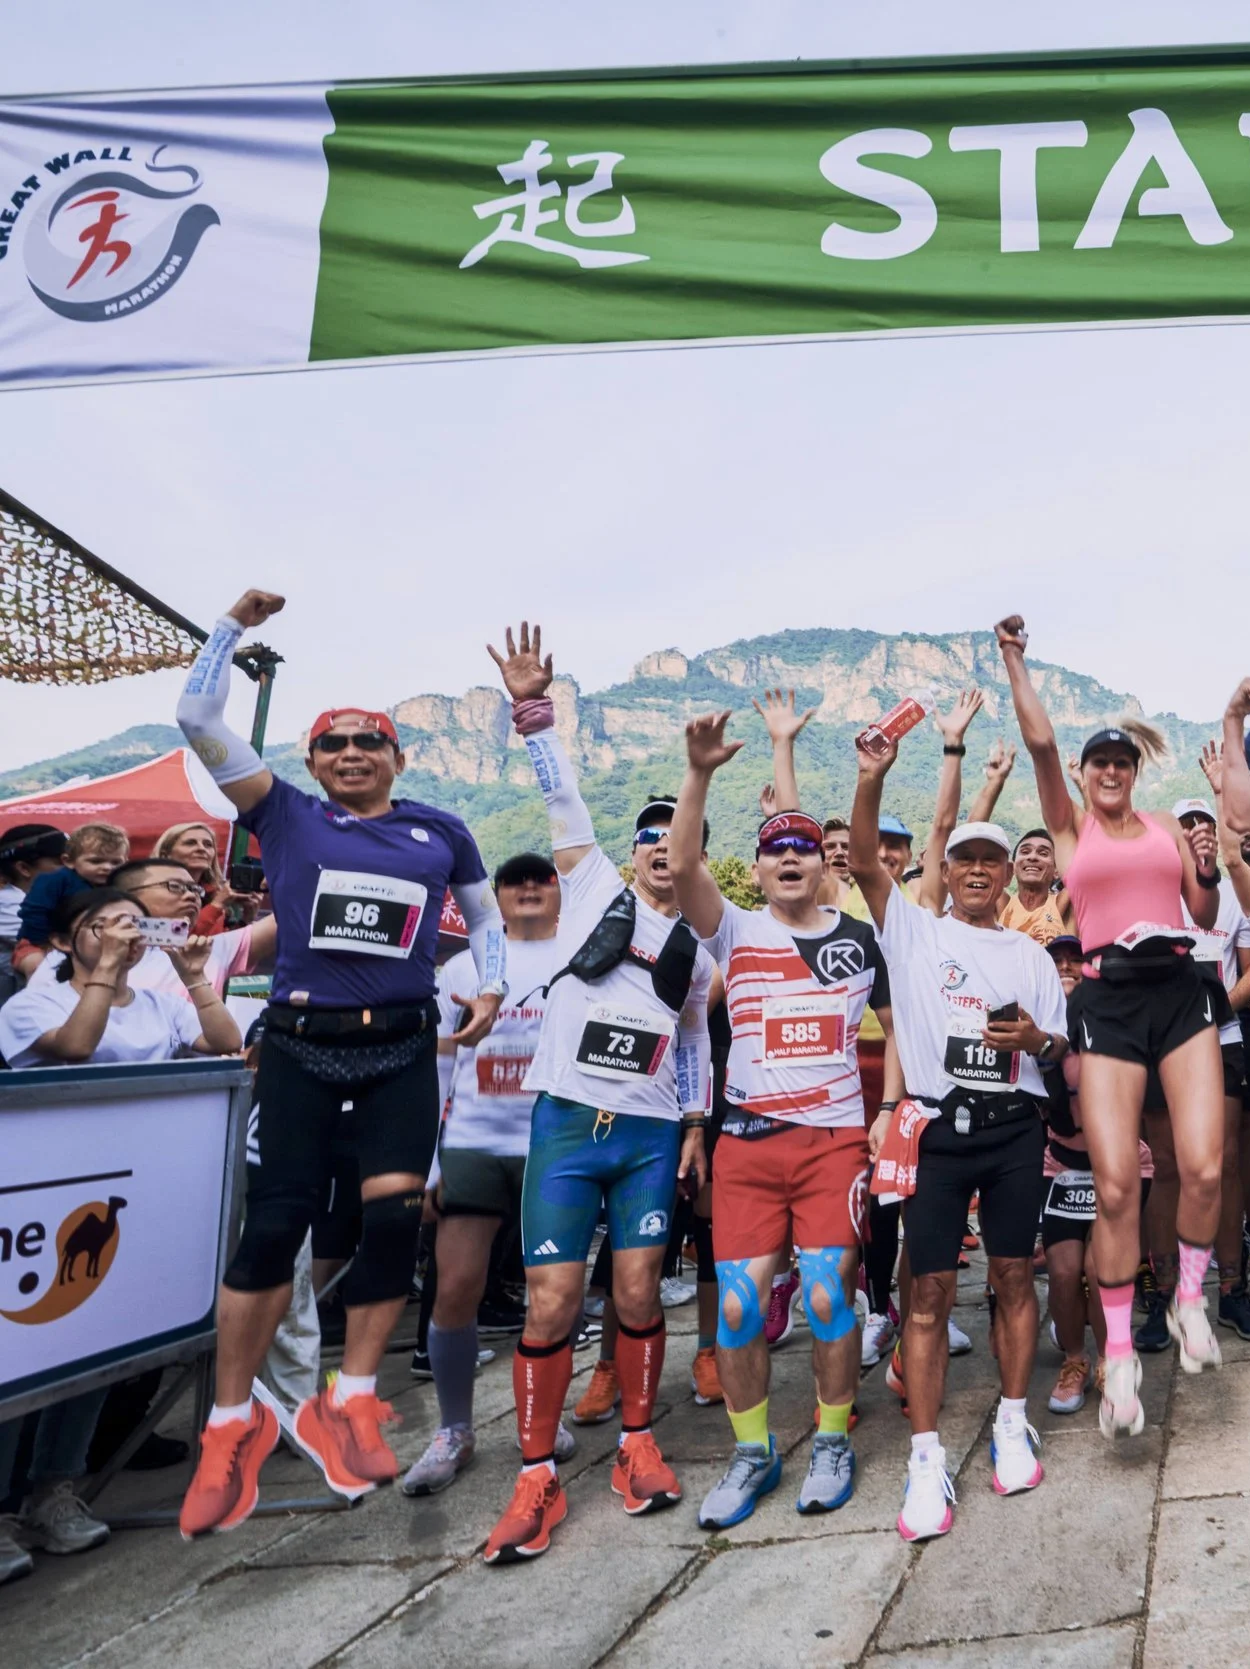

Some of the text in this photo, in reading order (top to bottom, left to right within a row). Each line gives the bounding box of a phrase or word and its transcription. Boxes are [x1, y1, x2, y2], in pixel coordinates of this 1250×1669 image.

[44, 147, 133, 175] WALL
[459, 140, 650, 269] 起
[104, 254, 183, 315] MARATHON
[344, 901, 380, 927] 96
[324, 925, 389, 943] MARATHON
[607, 1031, 636, 1056] 73
[781, 1022, 821, 1044] 585
[587, 1053, 640, 1070] MARATHON
[774, 1045, 828, 1056] HALF MARATHON
[964, 1044, 997, 1067] 118
[953, 1067, 1002, 1080] MARATHON
[1064, 1189, 1097, 1204] 309
